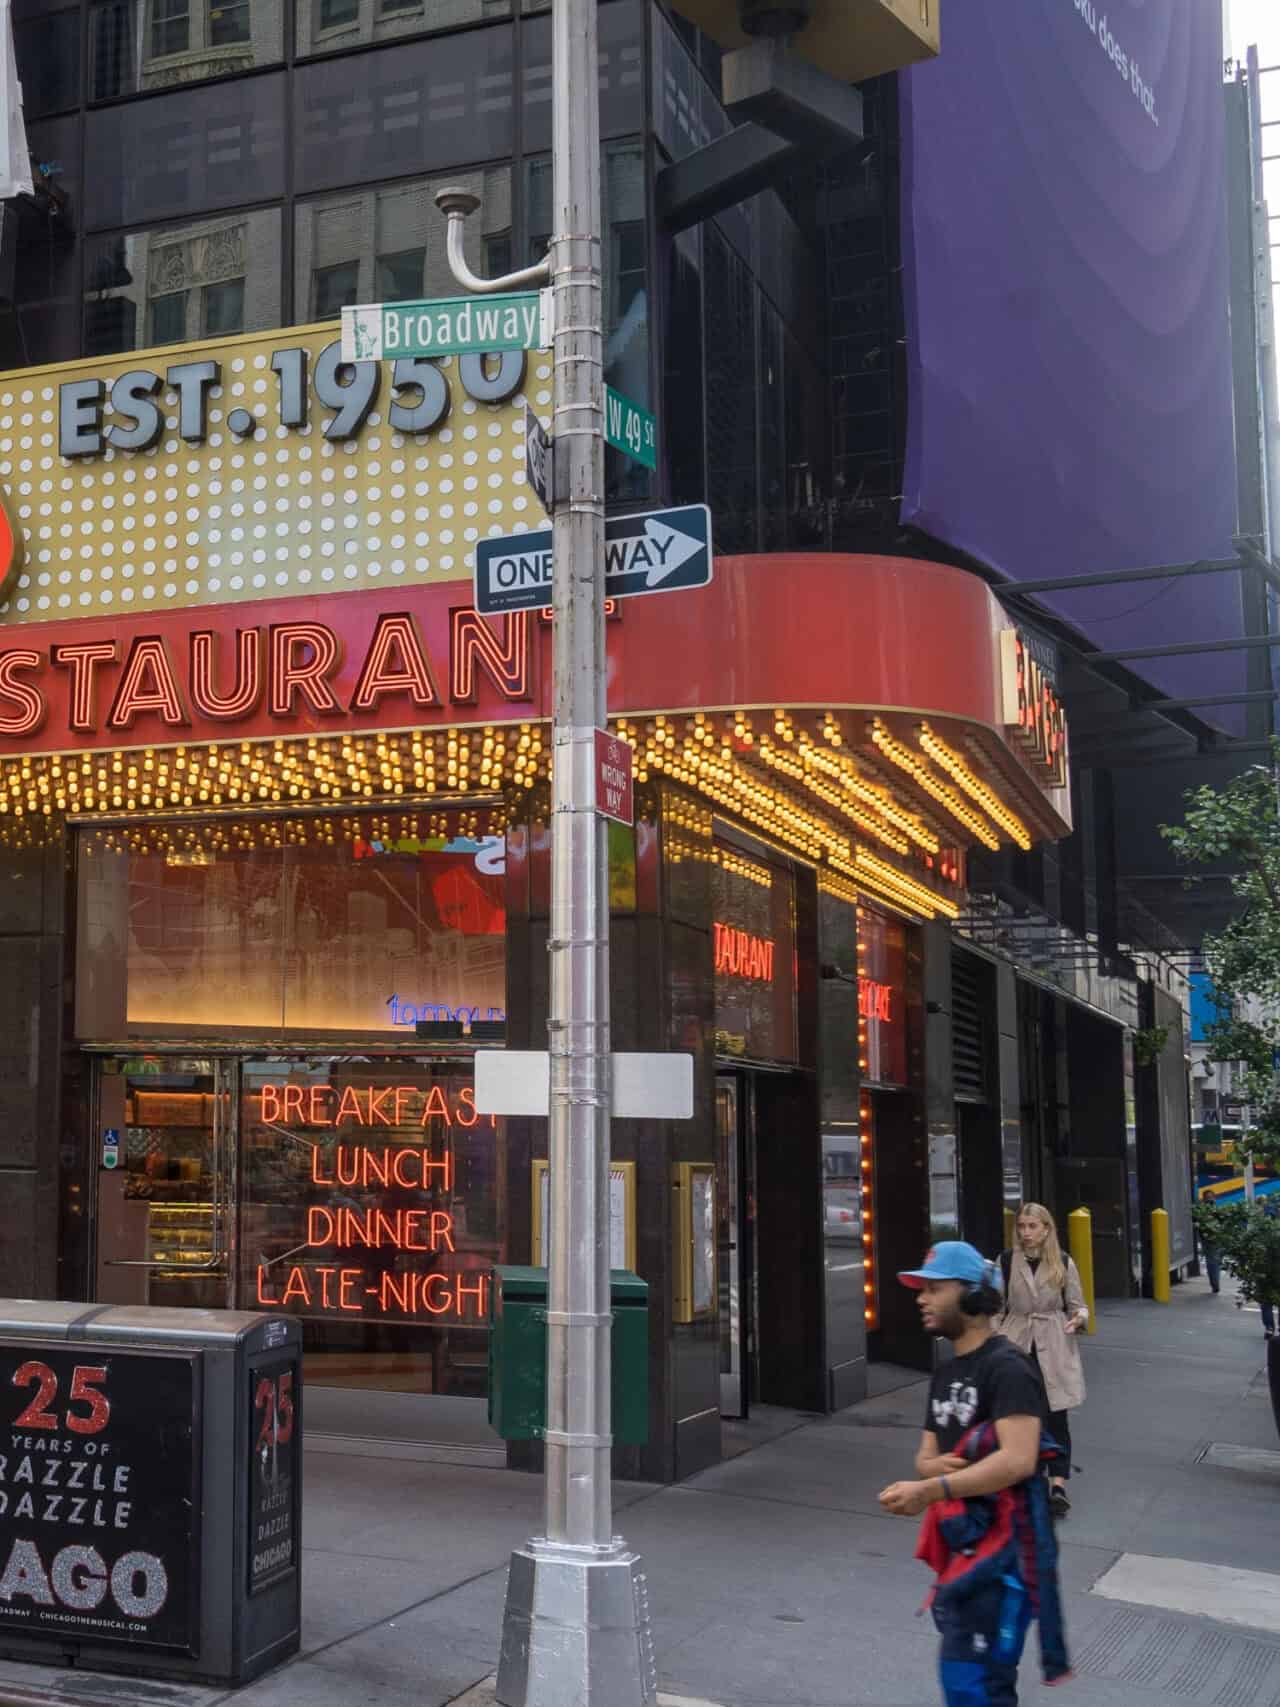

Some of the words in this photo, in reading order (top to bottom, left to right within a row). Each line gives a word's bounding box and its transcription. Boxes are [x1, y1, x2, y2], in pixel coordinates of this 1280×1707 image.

[1099, 16, 1129, 81] does
[384, 302, 537, 349] Broadway
[608, 394, 622, 441] W
[625, 408, 641, 453] 49
[605, 535, 674, 573] WAY
[601, 761, 627, 792] WRONG
[606, 787, 623, 811] WAY
[311, 1145, 449, 1191] LUNCH
[307, 1207, 455, 1252] DINNER
[257, 1264, 492, 1317] LATE-NIGH
[11, 1360, 111, 1435] 25
[255, 1372, 294, 1451] 25
[11, 1435, 73, 1453] YEARS
[84, 1442, 112, 1457] OF
